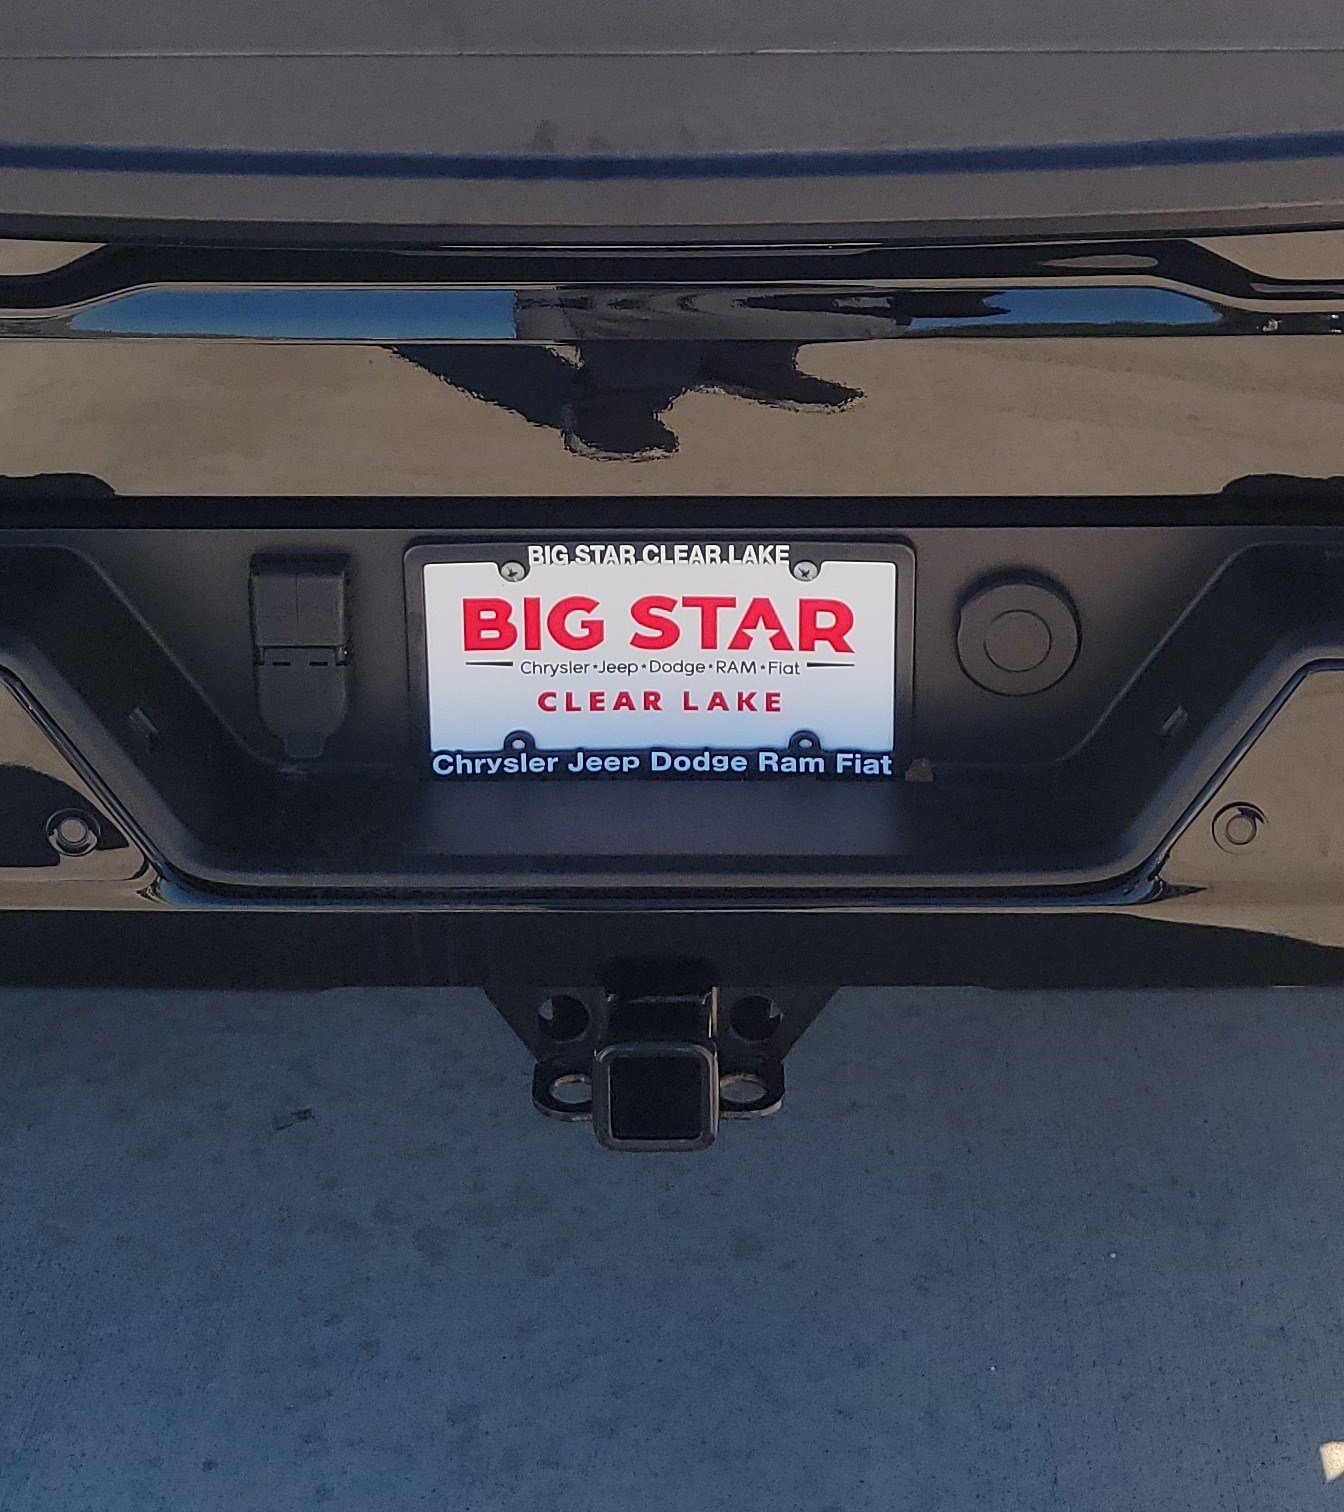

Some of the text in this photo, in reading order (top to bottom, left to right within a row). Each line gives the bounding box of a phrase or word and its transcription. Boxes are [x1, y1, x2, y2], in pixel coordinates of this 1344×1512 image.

[527, 544, 791, 566] BIG STAR CLEAR LAKE
[461, 595, 856, 654] BIG STAR
[519, 659, 801, 677] Chrysler Jeep Dodge RAM Fiat
[537, 690, 782, 713] CLEAR LAKE
[431, 751, 893, 776] Chrysler Jeep Dodge Ram Fiat
